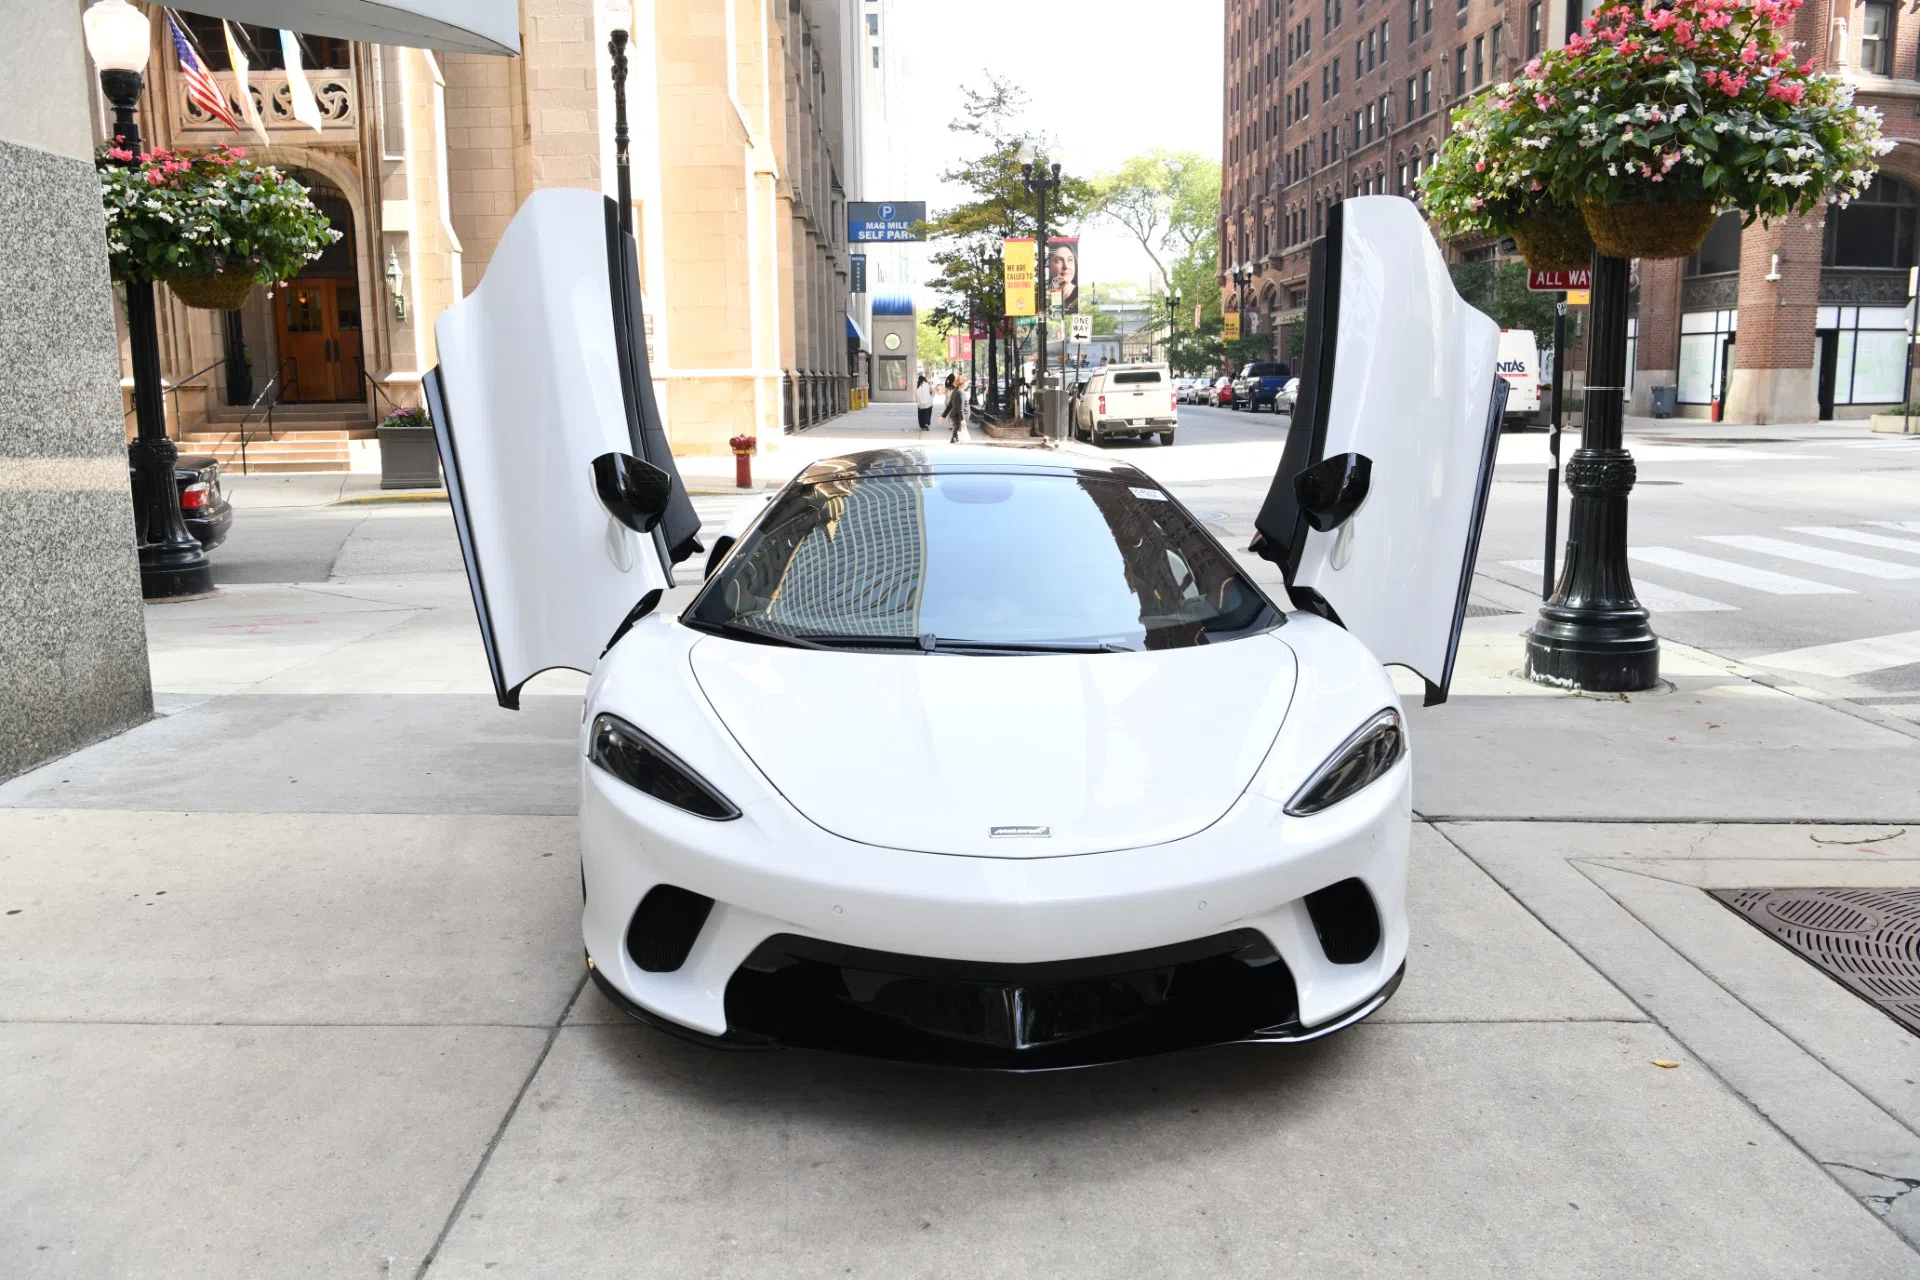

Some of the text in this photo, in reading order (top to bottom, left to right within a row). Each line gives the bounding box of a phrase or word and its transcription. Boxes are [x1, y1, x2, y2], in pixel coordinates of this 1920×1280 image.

[882, 205, 892, 218] P
[858, 230, 917, 239] SELF PARK
[1007, 264, 1026, 272] WE ARE
[1026, 272, 1034, 280] TO
[1536, 271, 1563, 286] ALL
[1073, 316, 1090, 325] ONE
